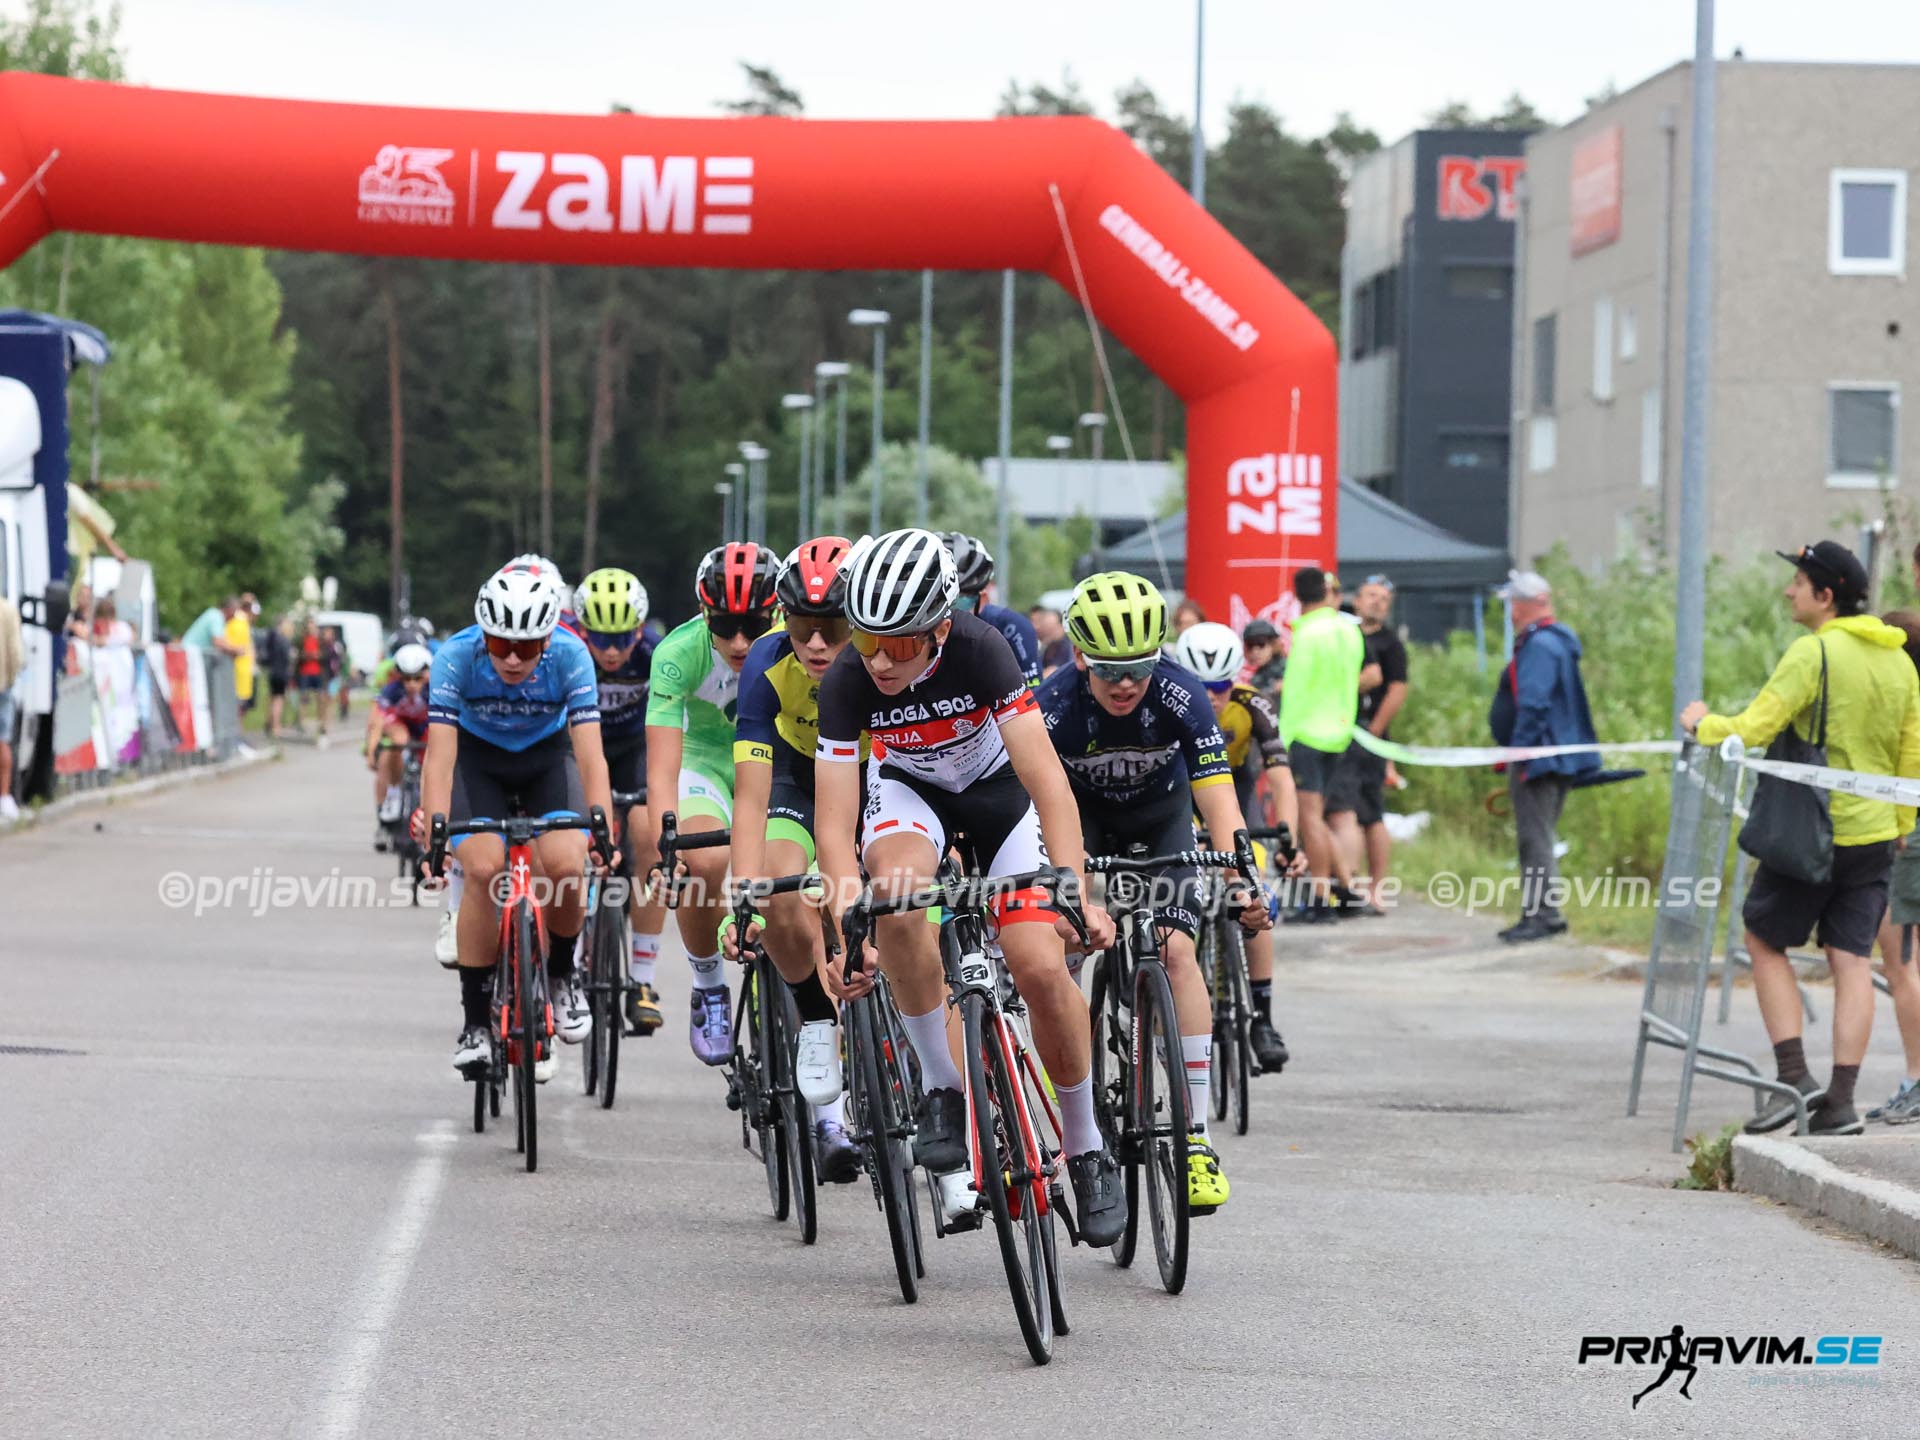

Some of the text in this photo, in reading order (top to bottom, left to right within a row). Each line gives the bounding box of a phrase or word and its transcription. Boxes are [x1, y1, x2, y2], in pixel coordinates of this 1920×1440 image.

[1167, 681, 1192, 706] FEEL
[870, 694, 977, 728] SLOGA 1902
